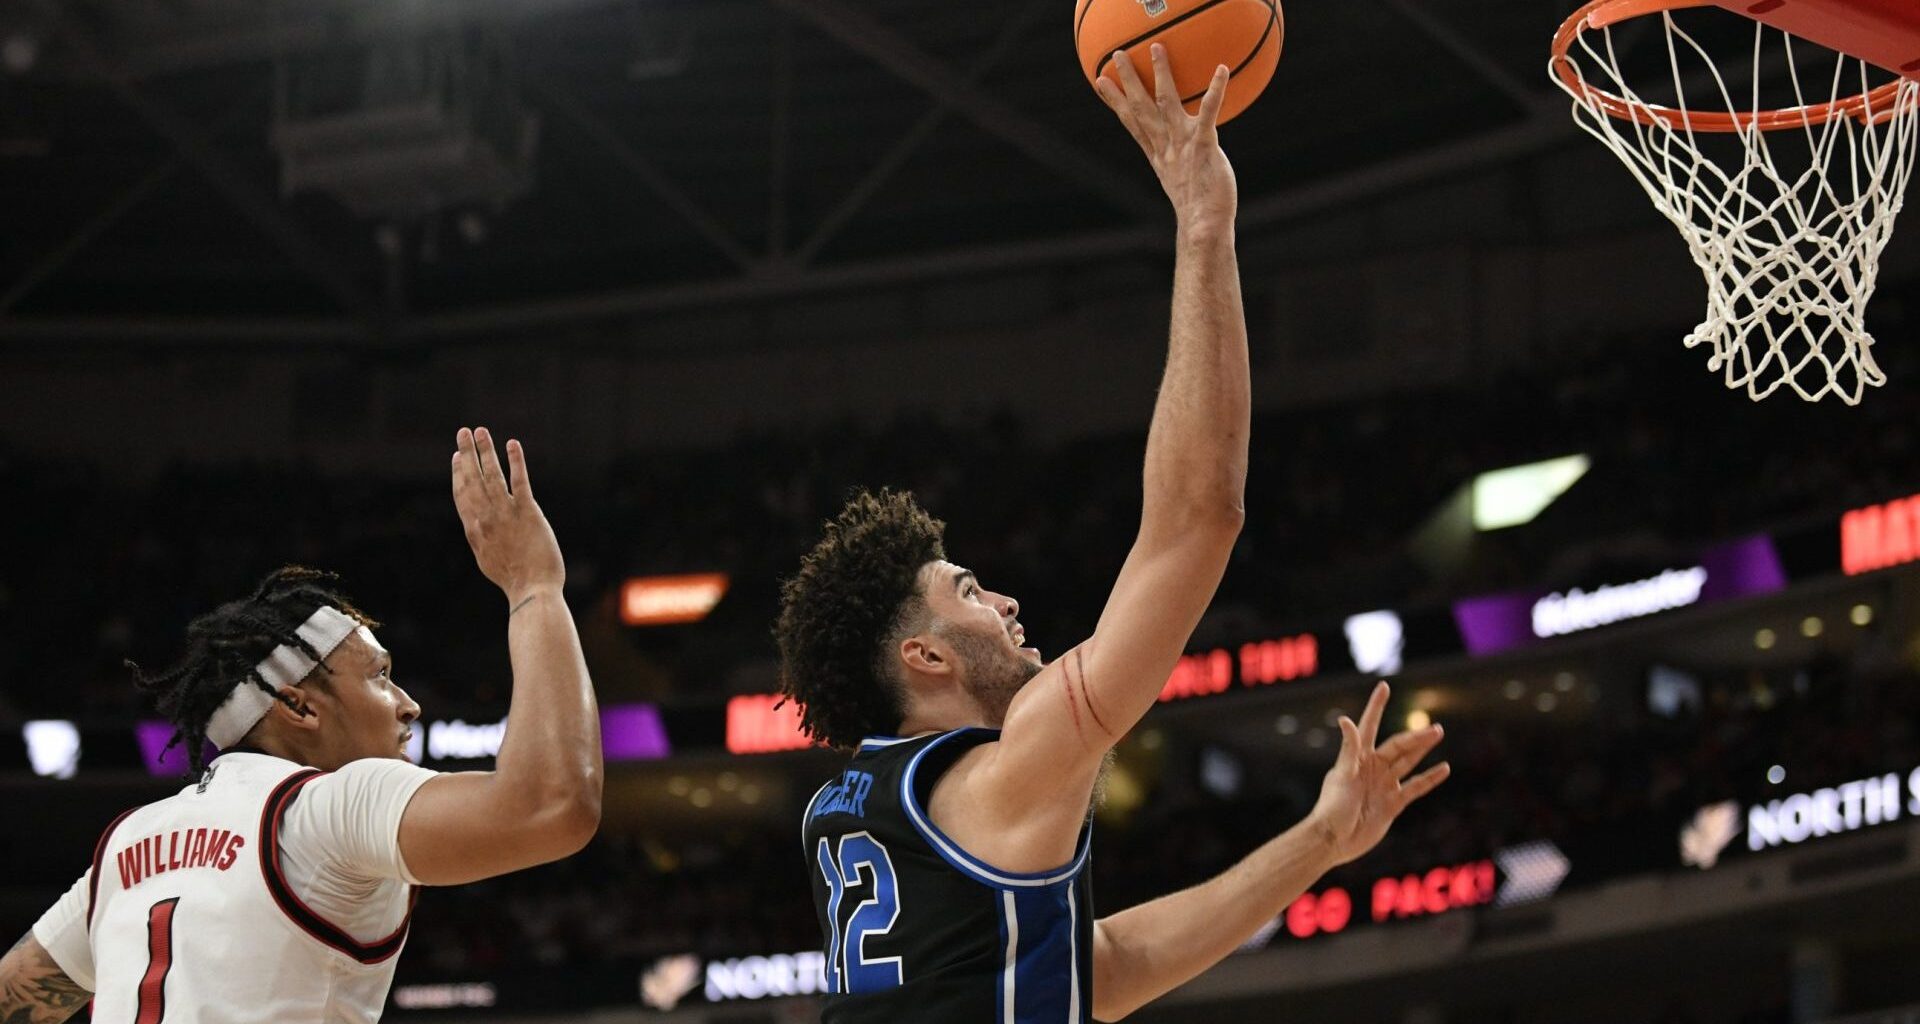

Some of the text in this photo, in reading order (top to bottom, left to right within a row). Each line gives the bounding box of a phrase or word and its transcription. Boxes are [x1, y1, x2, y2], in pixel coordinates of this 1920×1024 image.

[1748, 772, 1900, 851] NORTH
[117, 827, 245, 891] WILLIAMS
[1286, 858, 1496, 939] GO PACK!
[817, 830, 903, 994] 12
[134, 896, 181, 1024] 1
